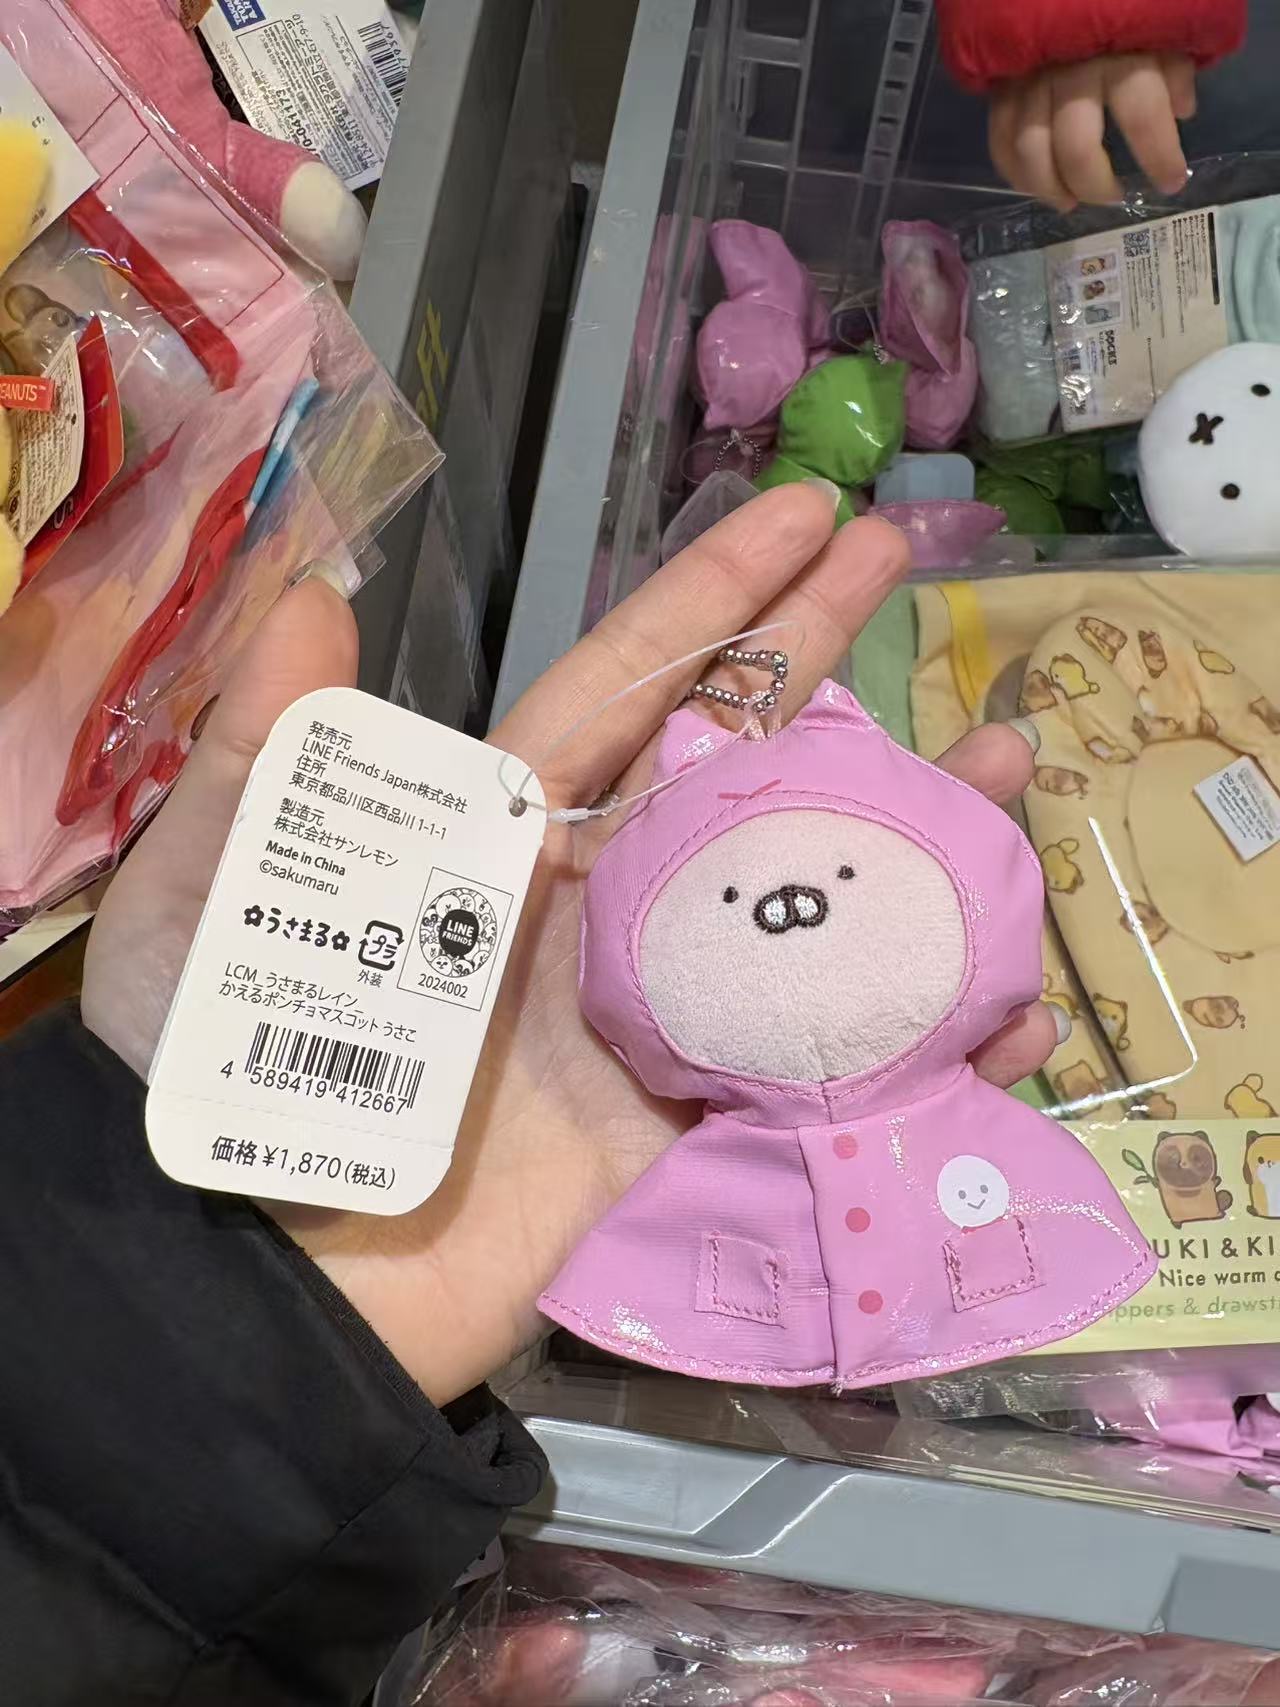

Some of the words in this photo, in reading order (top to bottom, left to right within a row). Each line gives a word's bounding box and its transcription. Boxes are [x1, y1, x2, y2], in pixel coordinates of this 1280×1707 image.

[274, 87, 319, 159] 70-041173
[0, 383, 38, 401] EANUTS
[309, 720, 352, 750] 発売元
[296, 753, 327, 778] 住所
[302, 737, 332, 761] LINE
[333, 750, 381, 778] Friends
[280, 797, 325, 827] 製造元
[273, 814, 399, 867] 株式会社サンレモン
[265, 840, 299, 861] Made
[301, 854, 312, 865] in
[314, 856, 346, 876] China
[259, 859, 339, 896] ©sakumaru
[267, 907, 331, 947] うさまる
[441, 931, 473, 947] FRIENDS
[446, 919, 474, 938] LINE
[369, 935, 398, 959] プラ
[357, 969, 384, 988] 外装
[417, 973, 468, 998] 2024002
[219, 981, 379, 1033] かえるポンチョマスコット
[383, 1021, 417, 1043] うさこ
[220, 1060, 234, 1079] 4
[250, 1066, 327, 1098] 589419
[336, 1086, 408, 1115] 412667
[211, 1136, 258, 1167] 価格
[262, 1145, 395, 1190] ¥1,870(税込)
[1152, 1238, 1209, 1259] UKI
[1221, 1237, 1239, 1258] &
[1247, 1235, 1275, 1257] KI
[1158, 1268, 1206, 1287] Nice
[1214, 1270, 1266, 1285] warm
[1184, 1297, 1200, 1315] &
